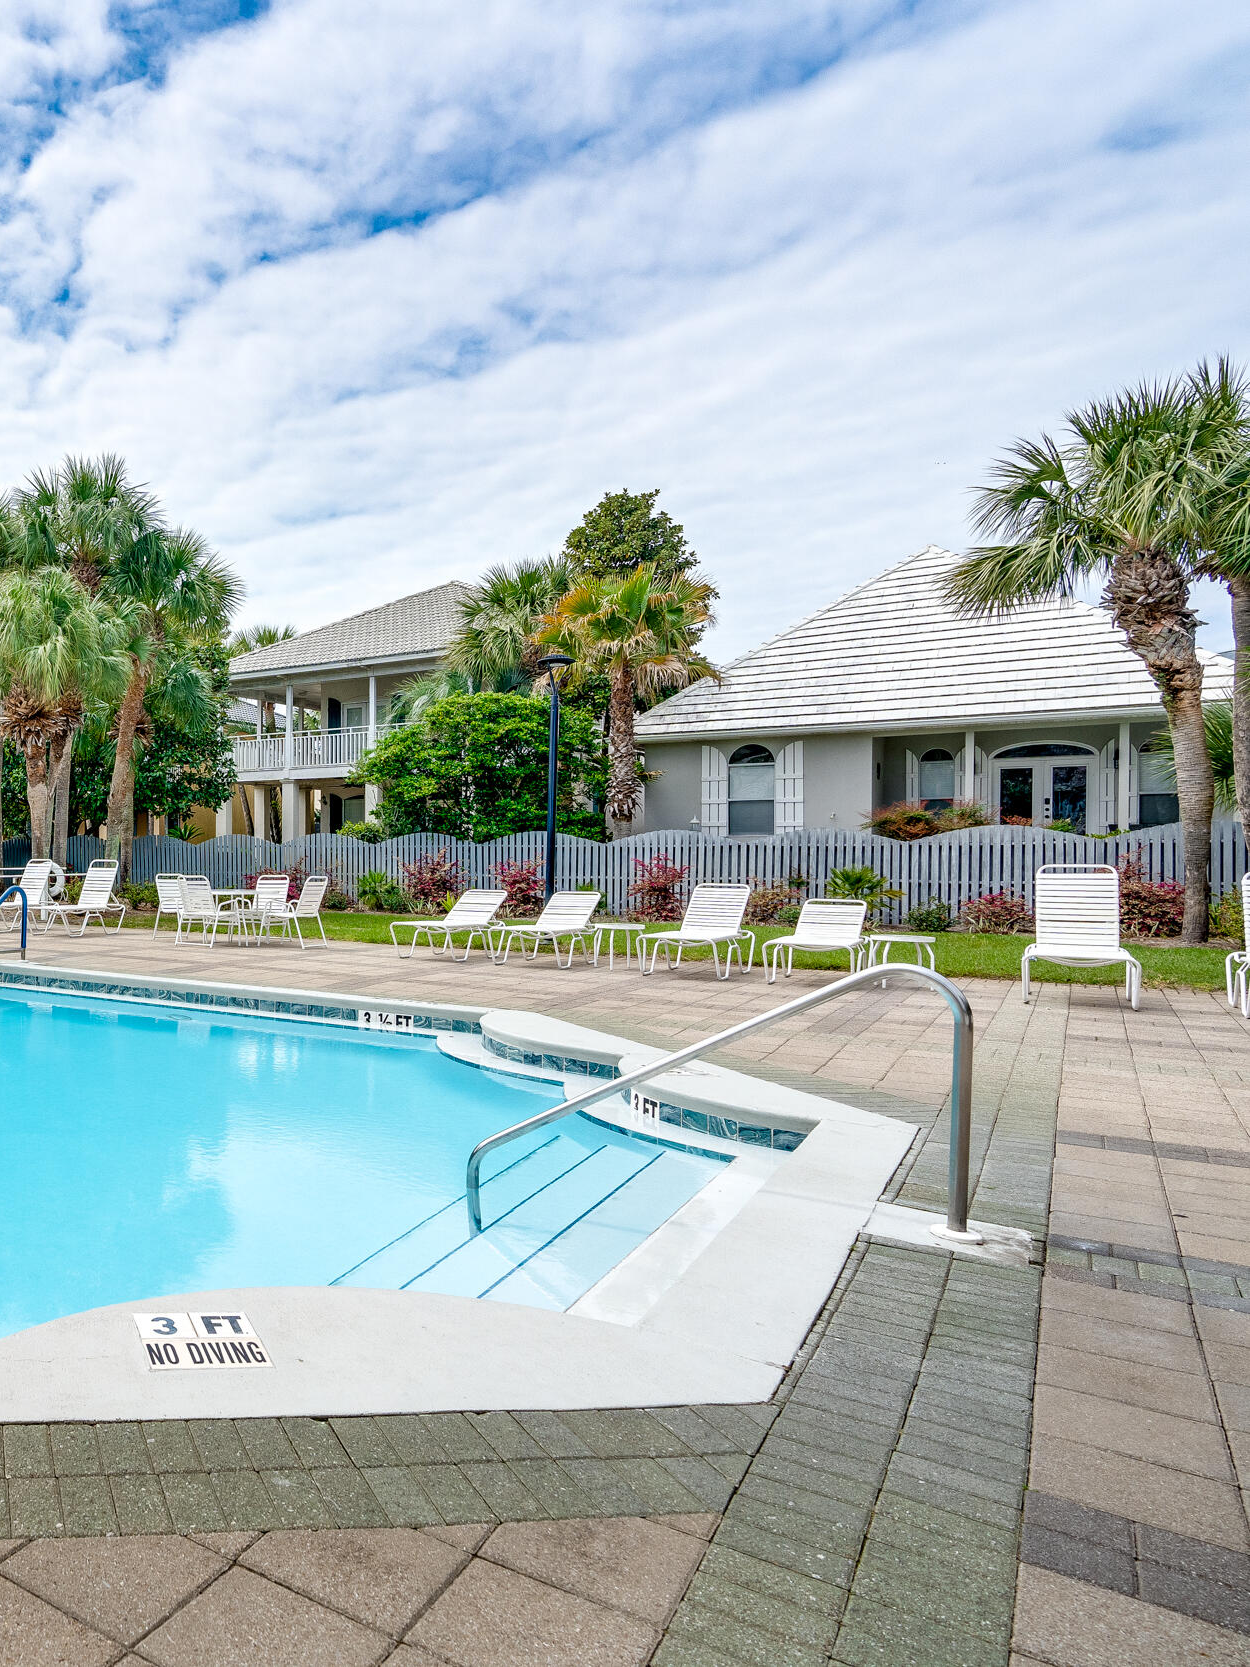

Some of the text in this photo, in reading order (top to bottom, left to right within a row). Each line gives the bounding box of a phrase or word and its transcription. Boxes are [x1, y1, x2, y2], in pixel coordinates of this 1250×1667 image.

[364, 1011, 371, 1023] 3
[396, 1014, 412, 1027] FT
[643, 1097, 658, 1118] FT
[151, 1317, 178, 1335] 3
[146, 1341, 267, 1365] NO DIVING
